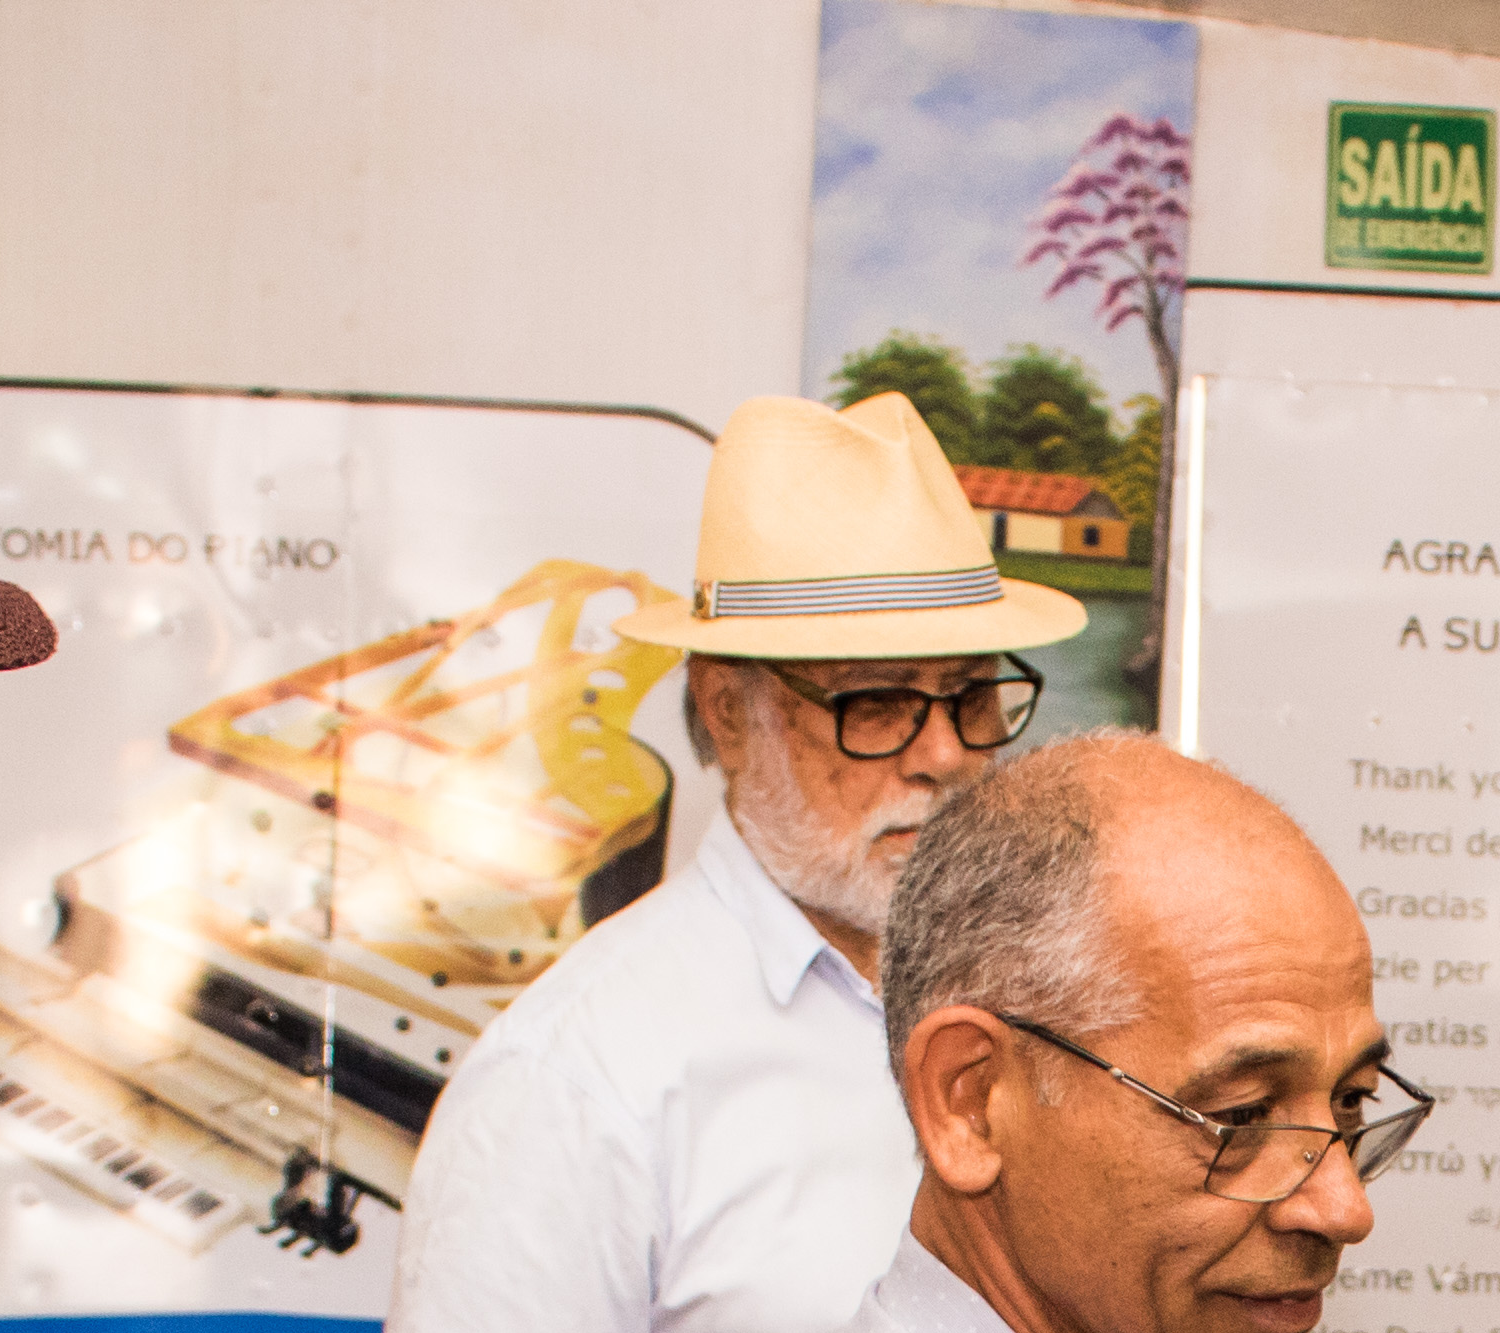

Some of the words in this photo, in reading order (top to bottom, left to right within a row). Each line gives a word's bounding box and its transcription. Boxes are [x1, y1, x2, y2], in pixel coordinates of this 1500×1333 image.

[1339, 123, 1485, 212] SAÍDA
[126, 530, 190, 565] DO
[202, 533, 342, 572] PIANO
[1398, 614, 1429, 651] A
[1348, 757, 1457, 793] Thank
[1358, 822, 1454, 857] Merci
[1356, 886, 1488, 922] Gracias
[1372, 954, 1421, 982] zie
[1432, 958, 1490, 990] per
[1384, 1018, 1489, 1050] ratias
